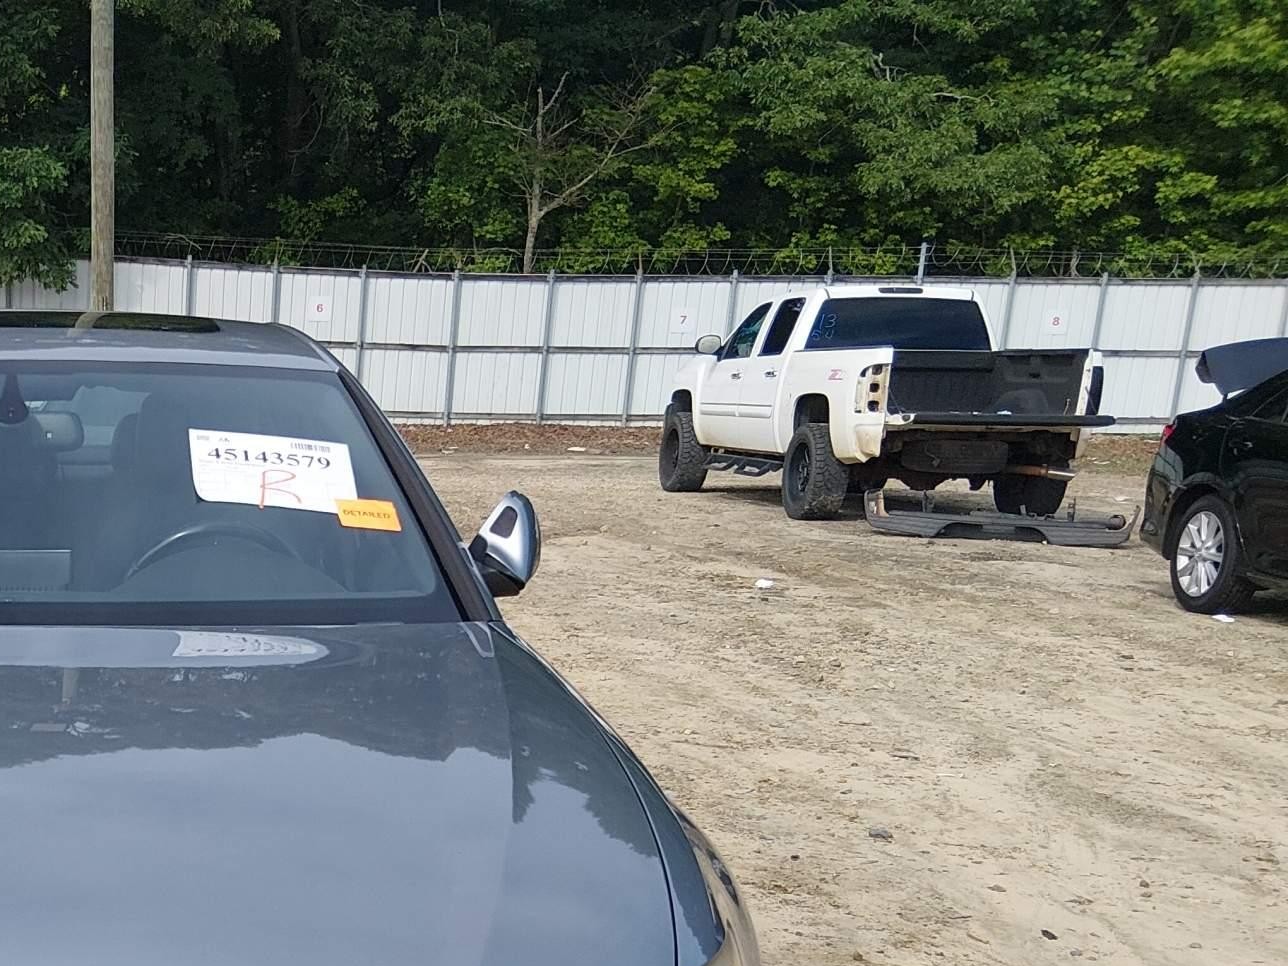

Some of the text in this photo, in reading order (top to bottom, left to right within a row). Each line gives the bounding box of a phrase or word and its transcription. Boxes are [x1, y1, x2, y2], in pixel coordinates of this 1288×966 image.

[316, 303, 324, 313] 6
[680, 315, 688, 325] 7
[1052, 317, 1060, 326] 8
[207, 447, 331, 469] 45143579
[259, 469, 302, 509] R
[342, 509, 392, 519] DETAILED
